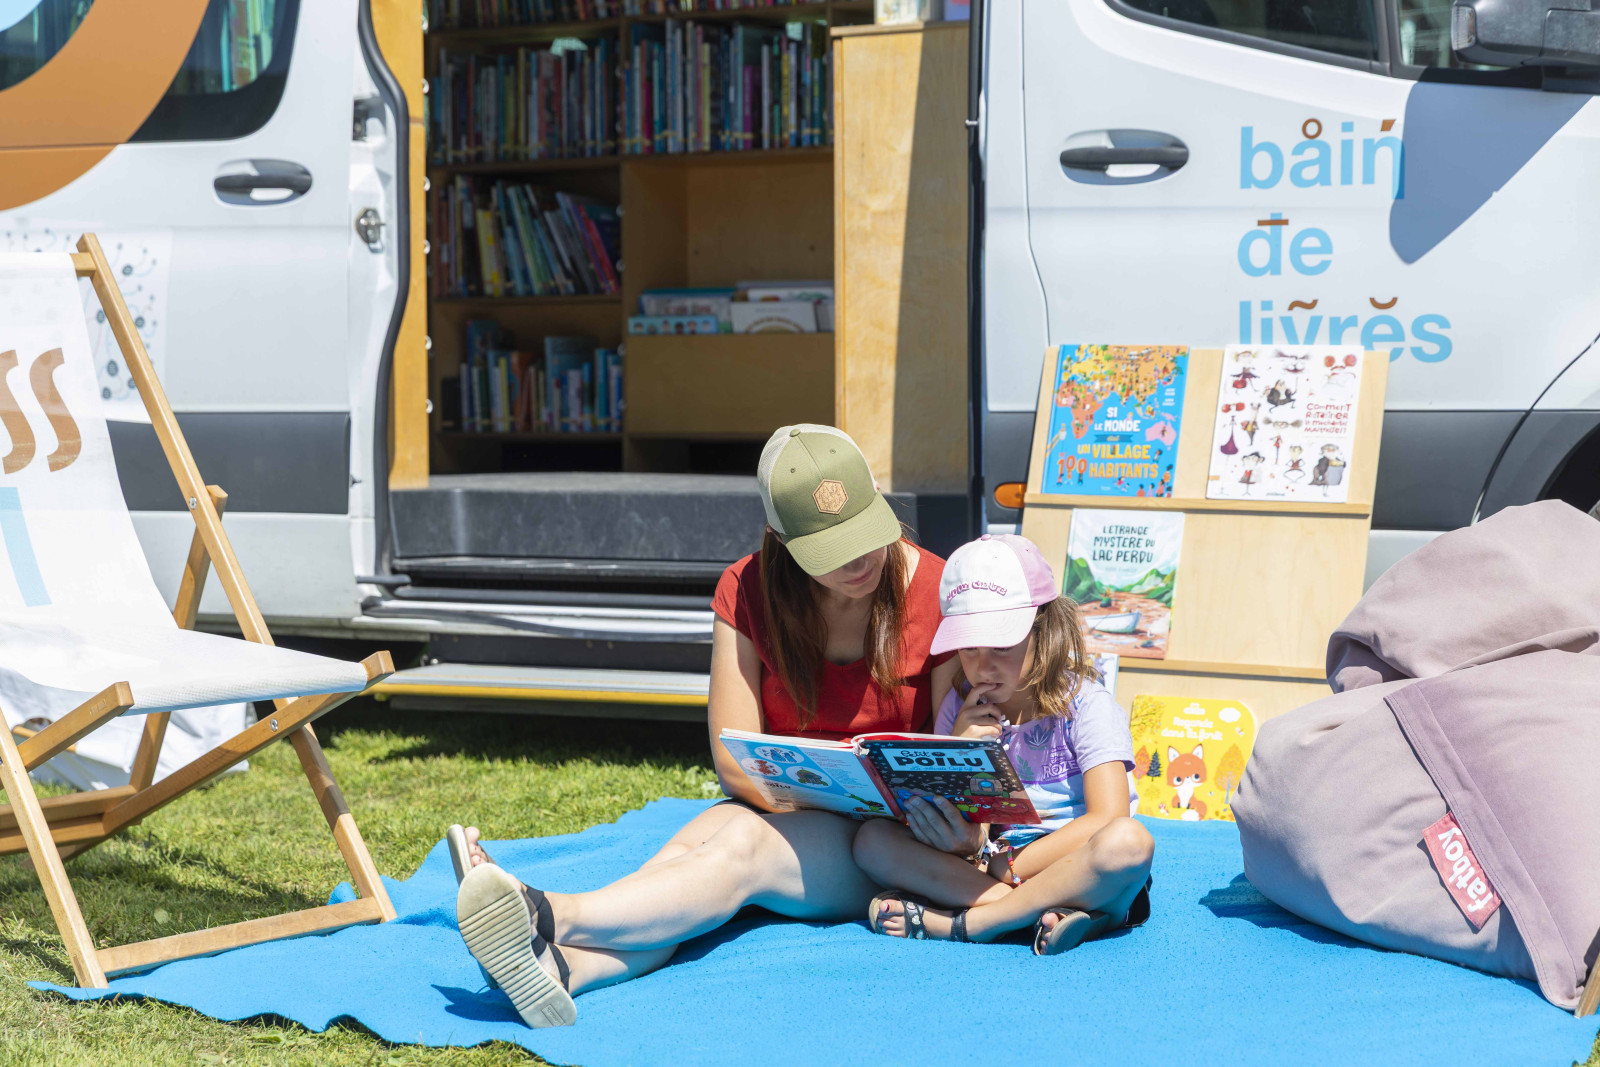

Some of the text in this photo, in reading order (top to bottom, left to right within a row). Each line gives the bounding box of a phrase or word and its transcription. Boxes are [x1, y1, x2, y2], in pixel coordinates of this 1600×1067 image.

[1106, 406, 1118, 418] SI
[1103, 419, 1141, 432] MONDE
[1077, 444, 1151, 460] UN VILLAGE
[1057, 455, 1159, 479] 100 HABITANTS
[1092, 549, 1153, 564] LAC PERDU
[1437, 826, 1494, 913] fatboy
